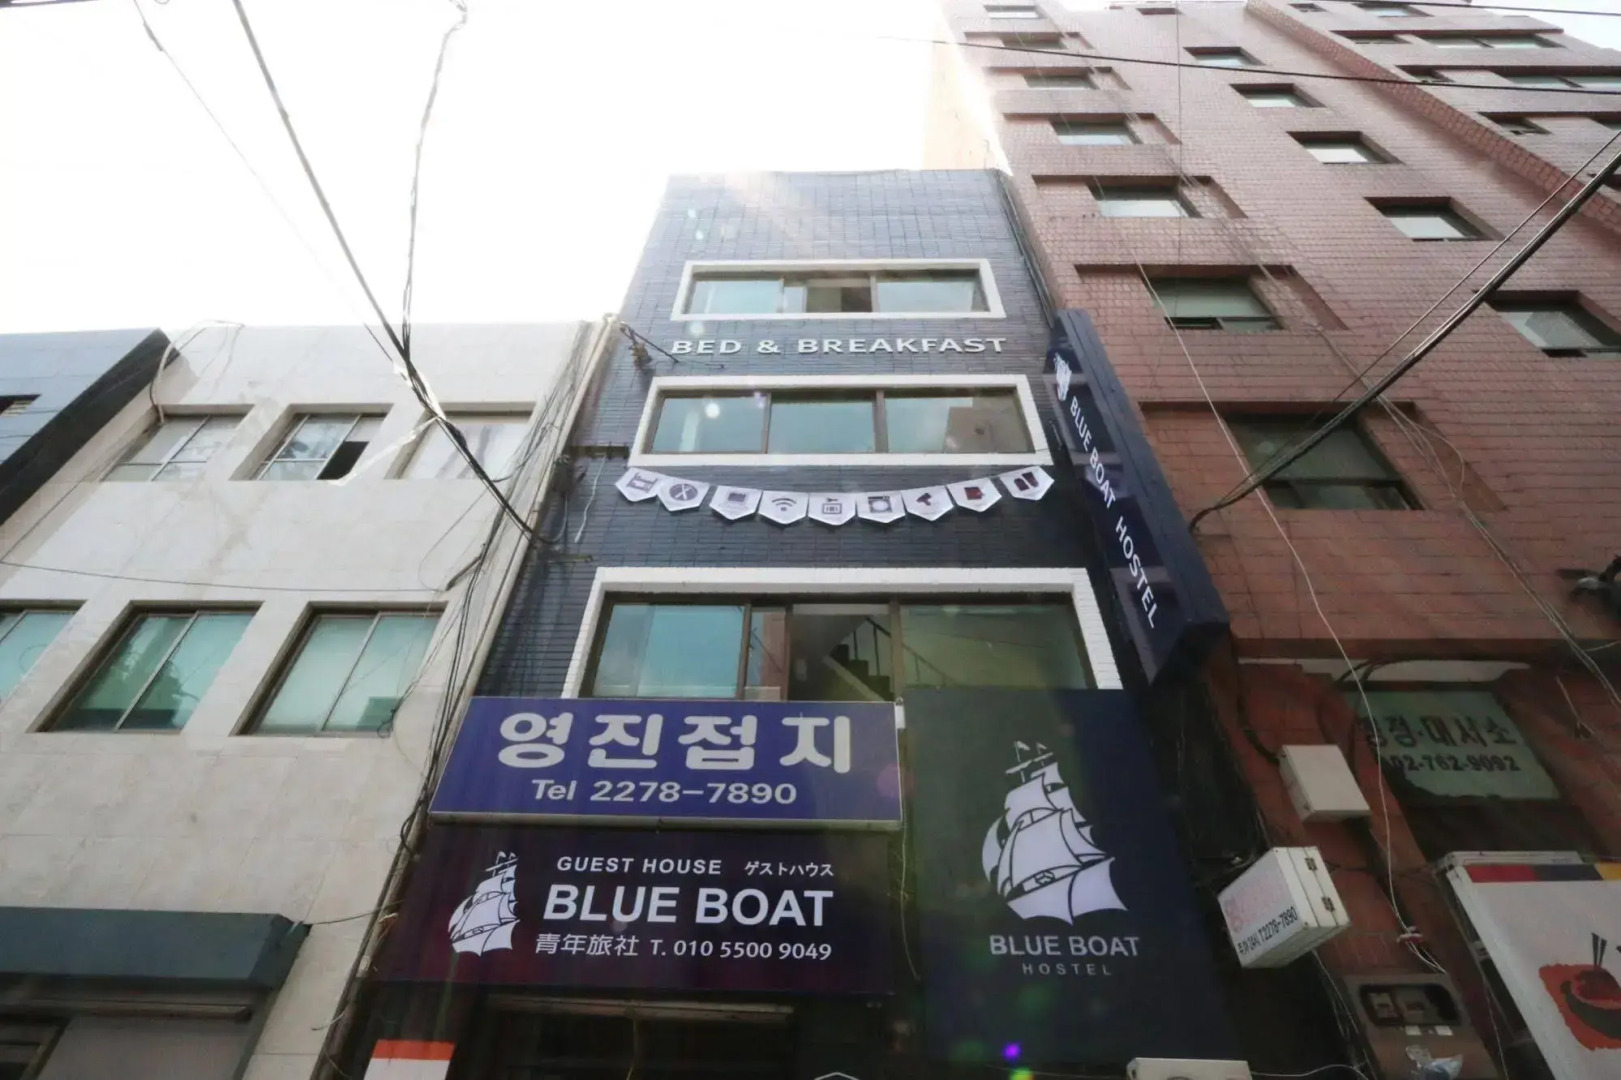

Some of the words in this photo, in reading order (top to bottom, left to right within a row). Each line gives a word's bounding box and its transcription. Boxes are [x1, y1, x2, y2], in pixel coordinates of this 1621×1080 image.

[671, 338, 742, 354] BED
[757, 338, 781, 354] &
[798, 337, 1008, 353] BREAKFAST
[1070, 396, 1094, 452] BLUE
[1090, 447, 1116, 509] BOAT
[1115, 516, 1158, 629] HOSTEL
[498, 712, 851, 774] 영진접지
[532, 779, 577, 801] Tel
[590, 780, 797, 805] 2278-7890
[556, 856, 634, 873] GUEST
[642, 858, 722, 875] HOUSE
[744, 860, 835, 877] ゲストハウス
[543, 884, 680, 923] BLUE
[695, 887, 834, 926] BOAT
[535, 933, 640, 957] 青年旅社
[650, 939, 667, 957] T.
[673, 940, 714, 957] 010
[720, 941, 773, 959] 5500
[778, 942, 832, 961] 9049
[989, 935, 1062, 956] BLUE
[1068, 936, 1140, 957] BOAT
[1022, 962, 1112, 976] HOSTEL
